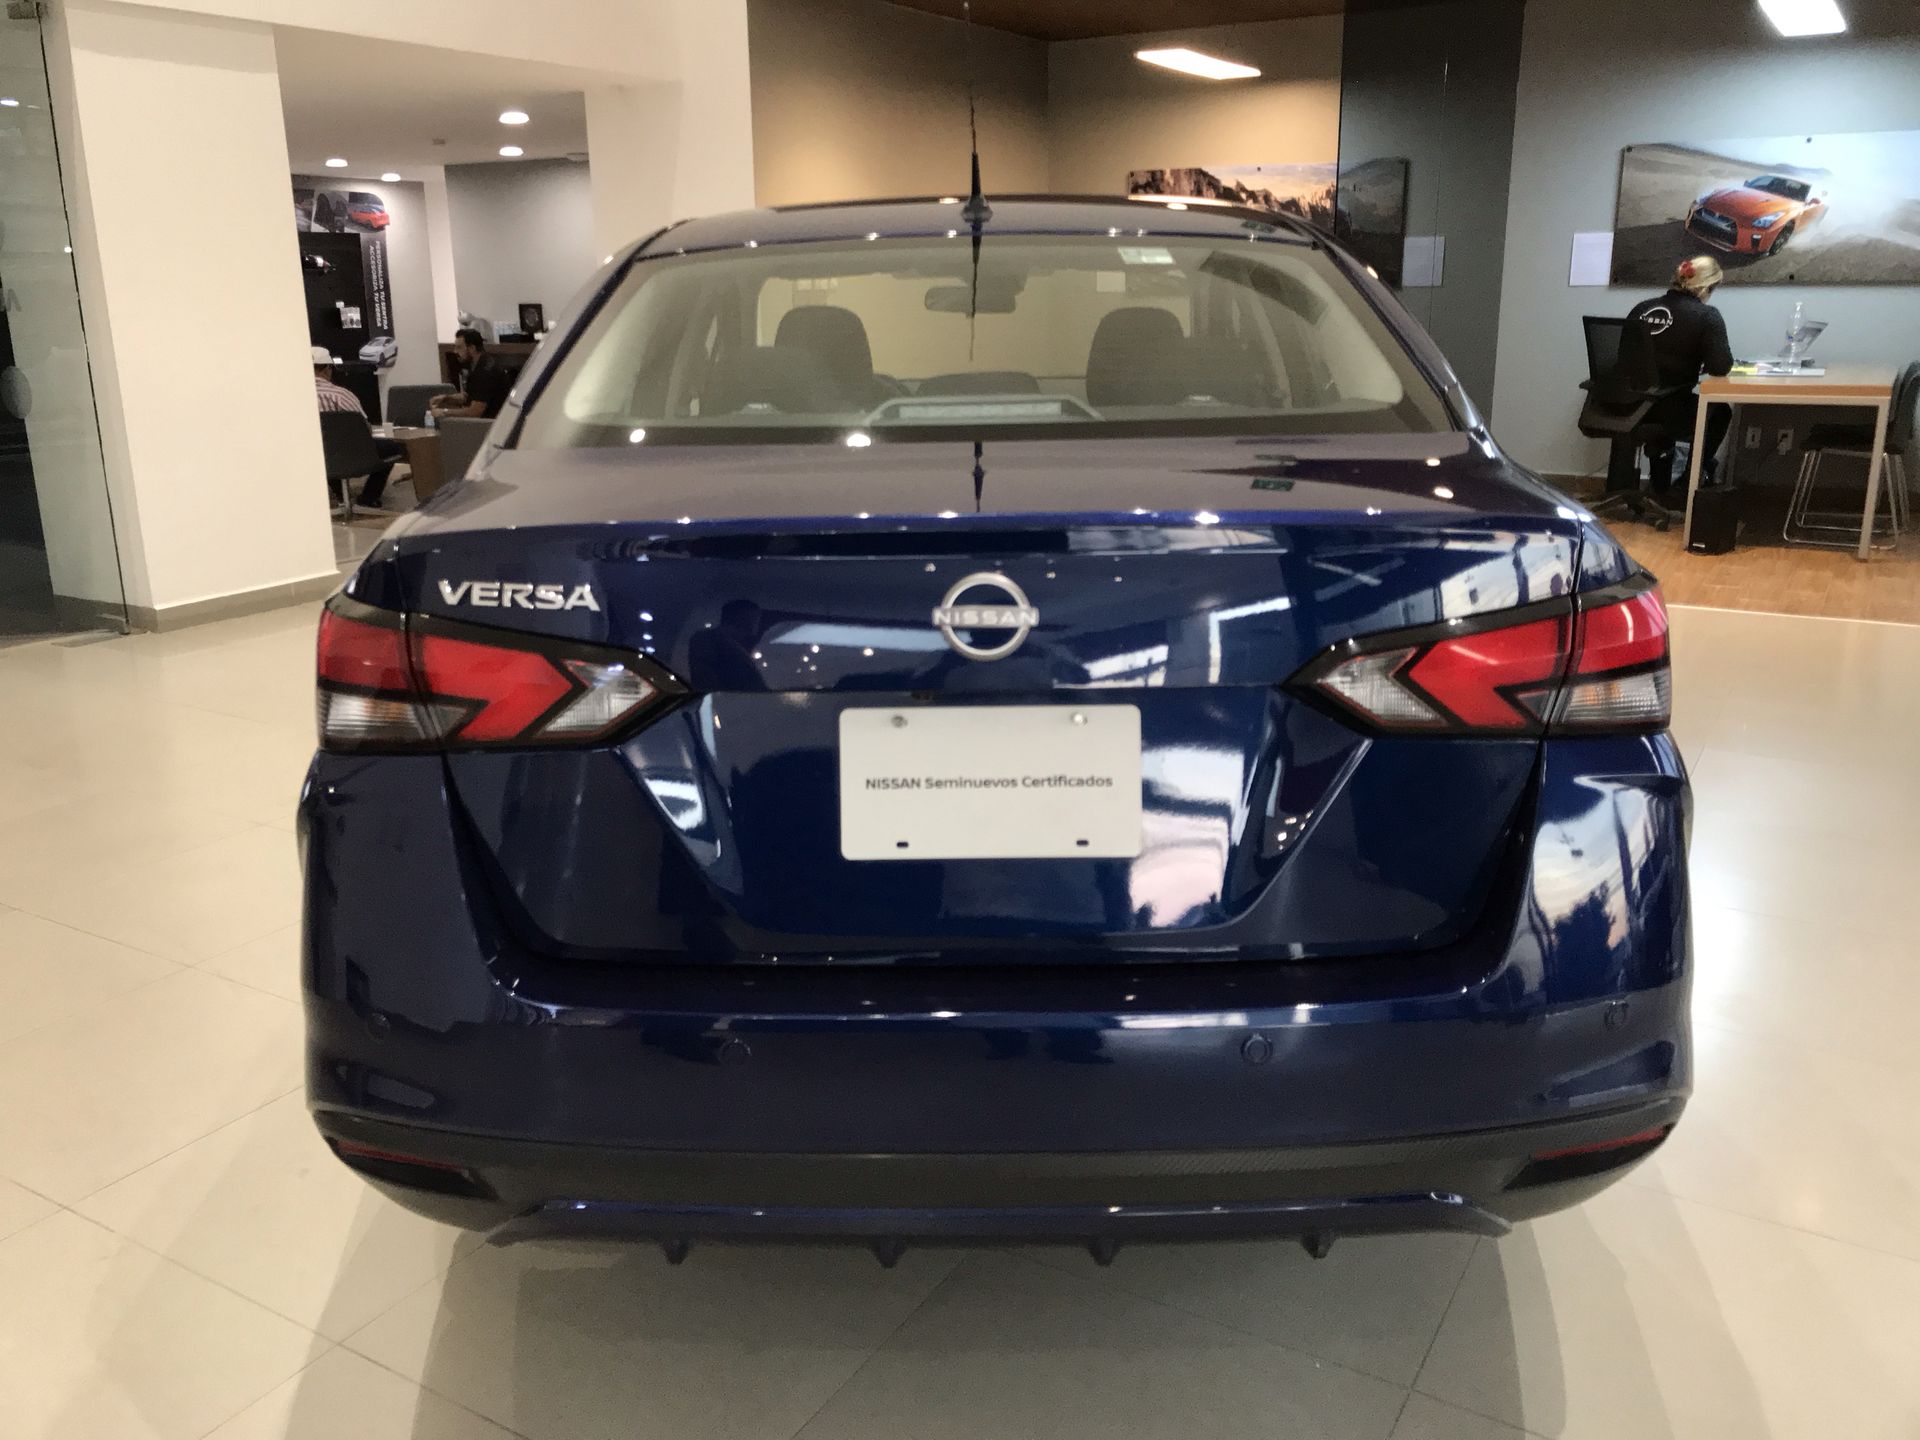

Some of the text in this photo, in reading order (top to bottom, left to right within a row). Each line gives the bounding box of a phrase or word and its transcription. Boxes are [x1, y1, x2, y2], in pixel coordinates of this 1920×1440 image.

[375, 241, 384, 289] PERSONALIZA
[380, 291, 387, 300] TU
[374, 292, 380, 302] TU
[438, 579, 601, 612] VERSA
[933, 609, 1039, 626] NISSAN
[866, 775, 1113, 790] NISSAN Seminuevos Certificados
